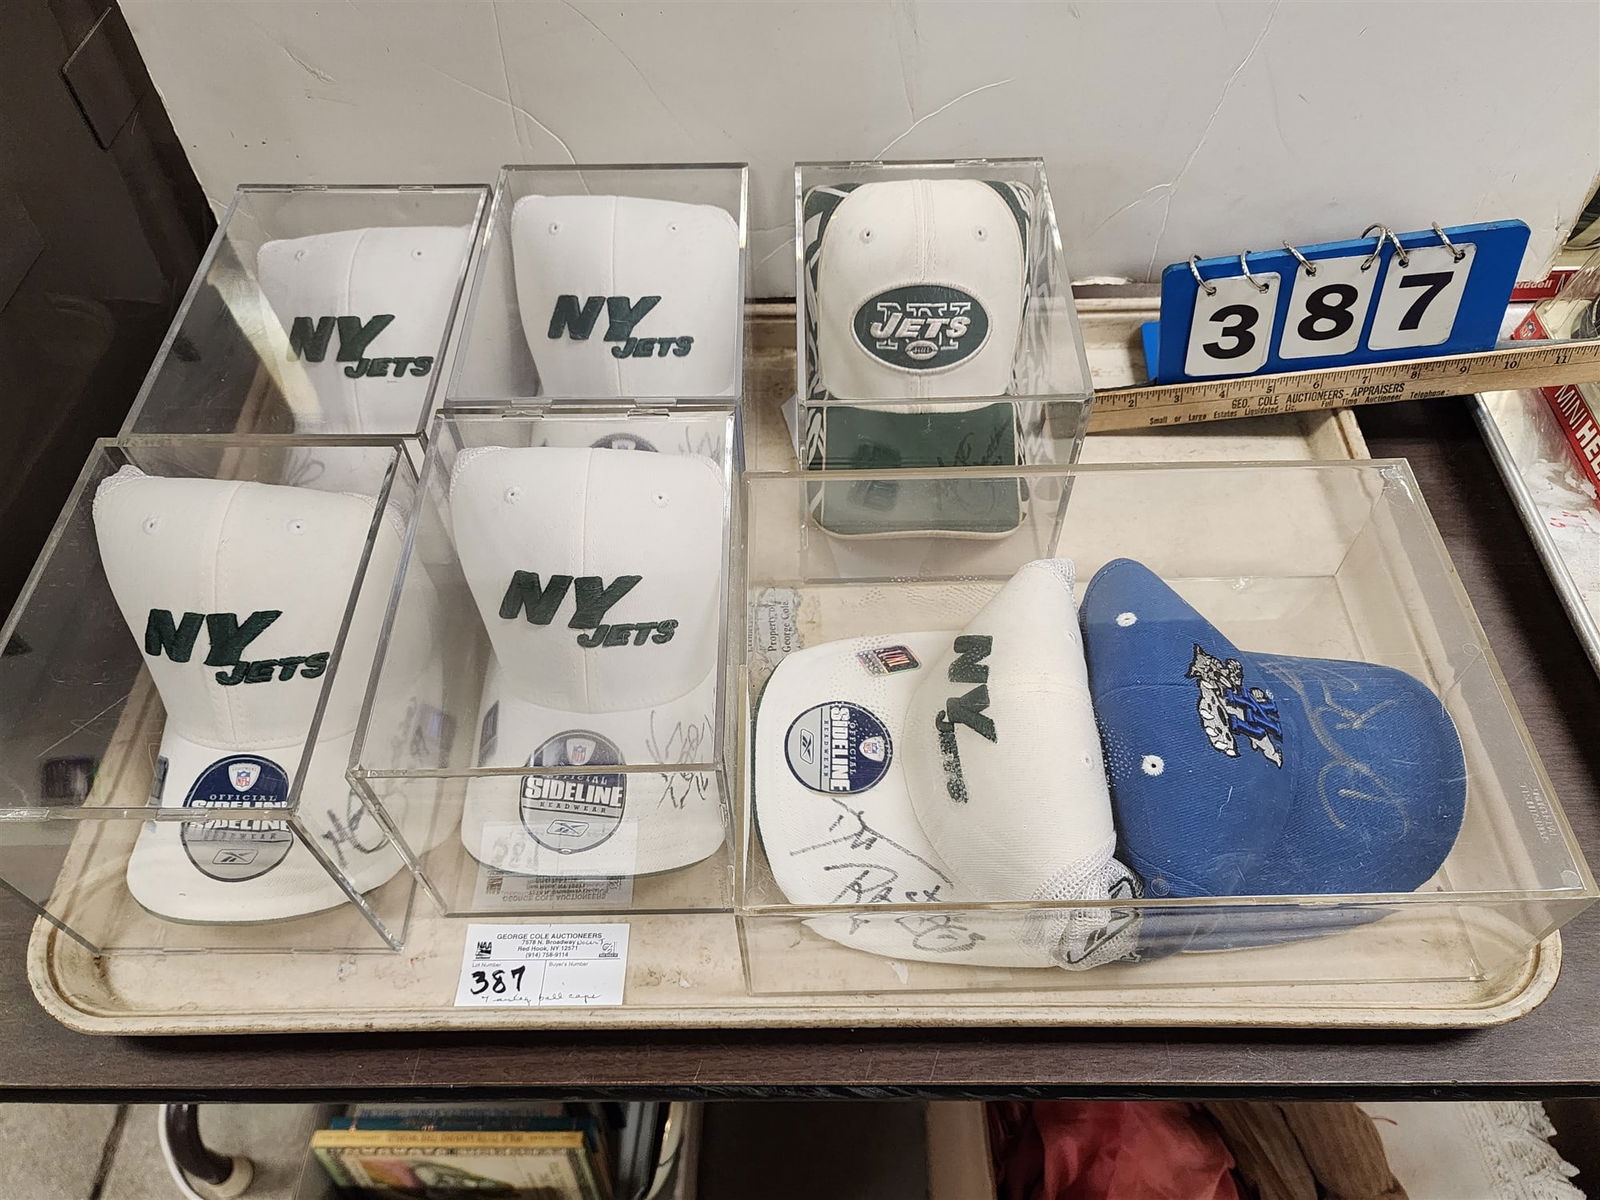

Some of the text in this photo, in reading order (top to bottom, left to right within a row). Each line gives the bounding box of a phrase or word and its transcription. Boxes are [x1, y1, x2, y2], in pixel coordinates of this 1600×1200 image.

[547, 295, 662, 341] NY
[870, 312, 971, 339] JETS
[287, 314, 395, 362] NY
[611, 336, 694, 359] JETS
[344, 356, 434, 378] JETS
[1173, 395, 1180, 403] 3
[1219, 390, 1226, 398] 4
[1265, 386, 1273, 394] 5
[1312, 381, 1320, 389] 6
[1362, 376, 1369, 384] 7
[1410, 371, 1418, 379] 8
[1459, 366, 1467, 374] 9
[1503, 361, 1517, 370] 10
[1553, 355, 1568, 365] 11
[1231, 398, 1250, 409] GEO.
[1258, 396, 1280, 407] COLE
[1286, 389, 1344, 404] AUCTIONEERS
[1351, 382, 1406, 398] APPRAISERS
[1364, 393, 1403, 404] Auctioneer
[1554, 384, 1588, 431] MINI
[1149, 416, 1168, 425] Small
[1188, 413, 1207, 422] Large
[1213, 410, 1238, 419] Estates
[498, 569, 643, 629] NY
[145, 608, 283, 666] NY
[576, 619, 679, 648] JETS
[781, 601, 792, 653] George Cole
[215, 652, 330, 685] JETS
[948, 634, 998, 745] NY
[830, 706, 851, 791] SIDELINE
[849, 722, 857, 775] OFFICIAL
[525, 777, 624, 807] SIDELINE
[540, 801, 606, 813] HEADWEAR
[551, 932, 603, 940] AUCTIONEERS
[470, 964, 526, 995] 387
